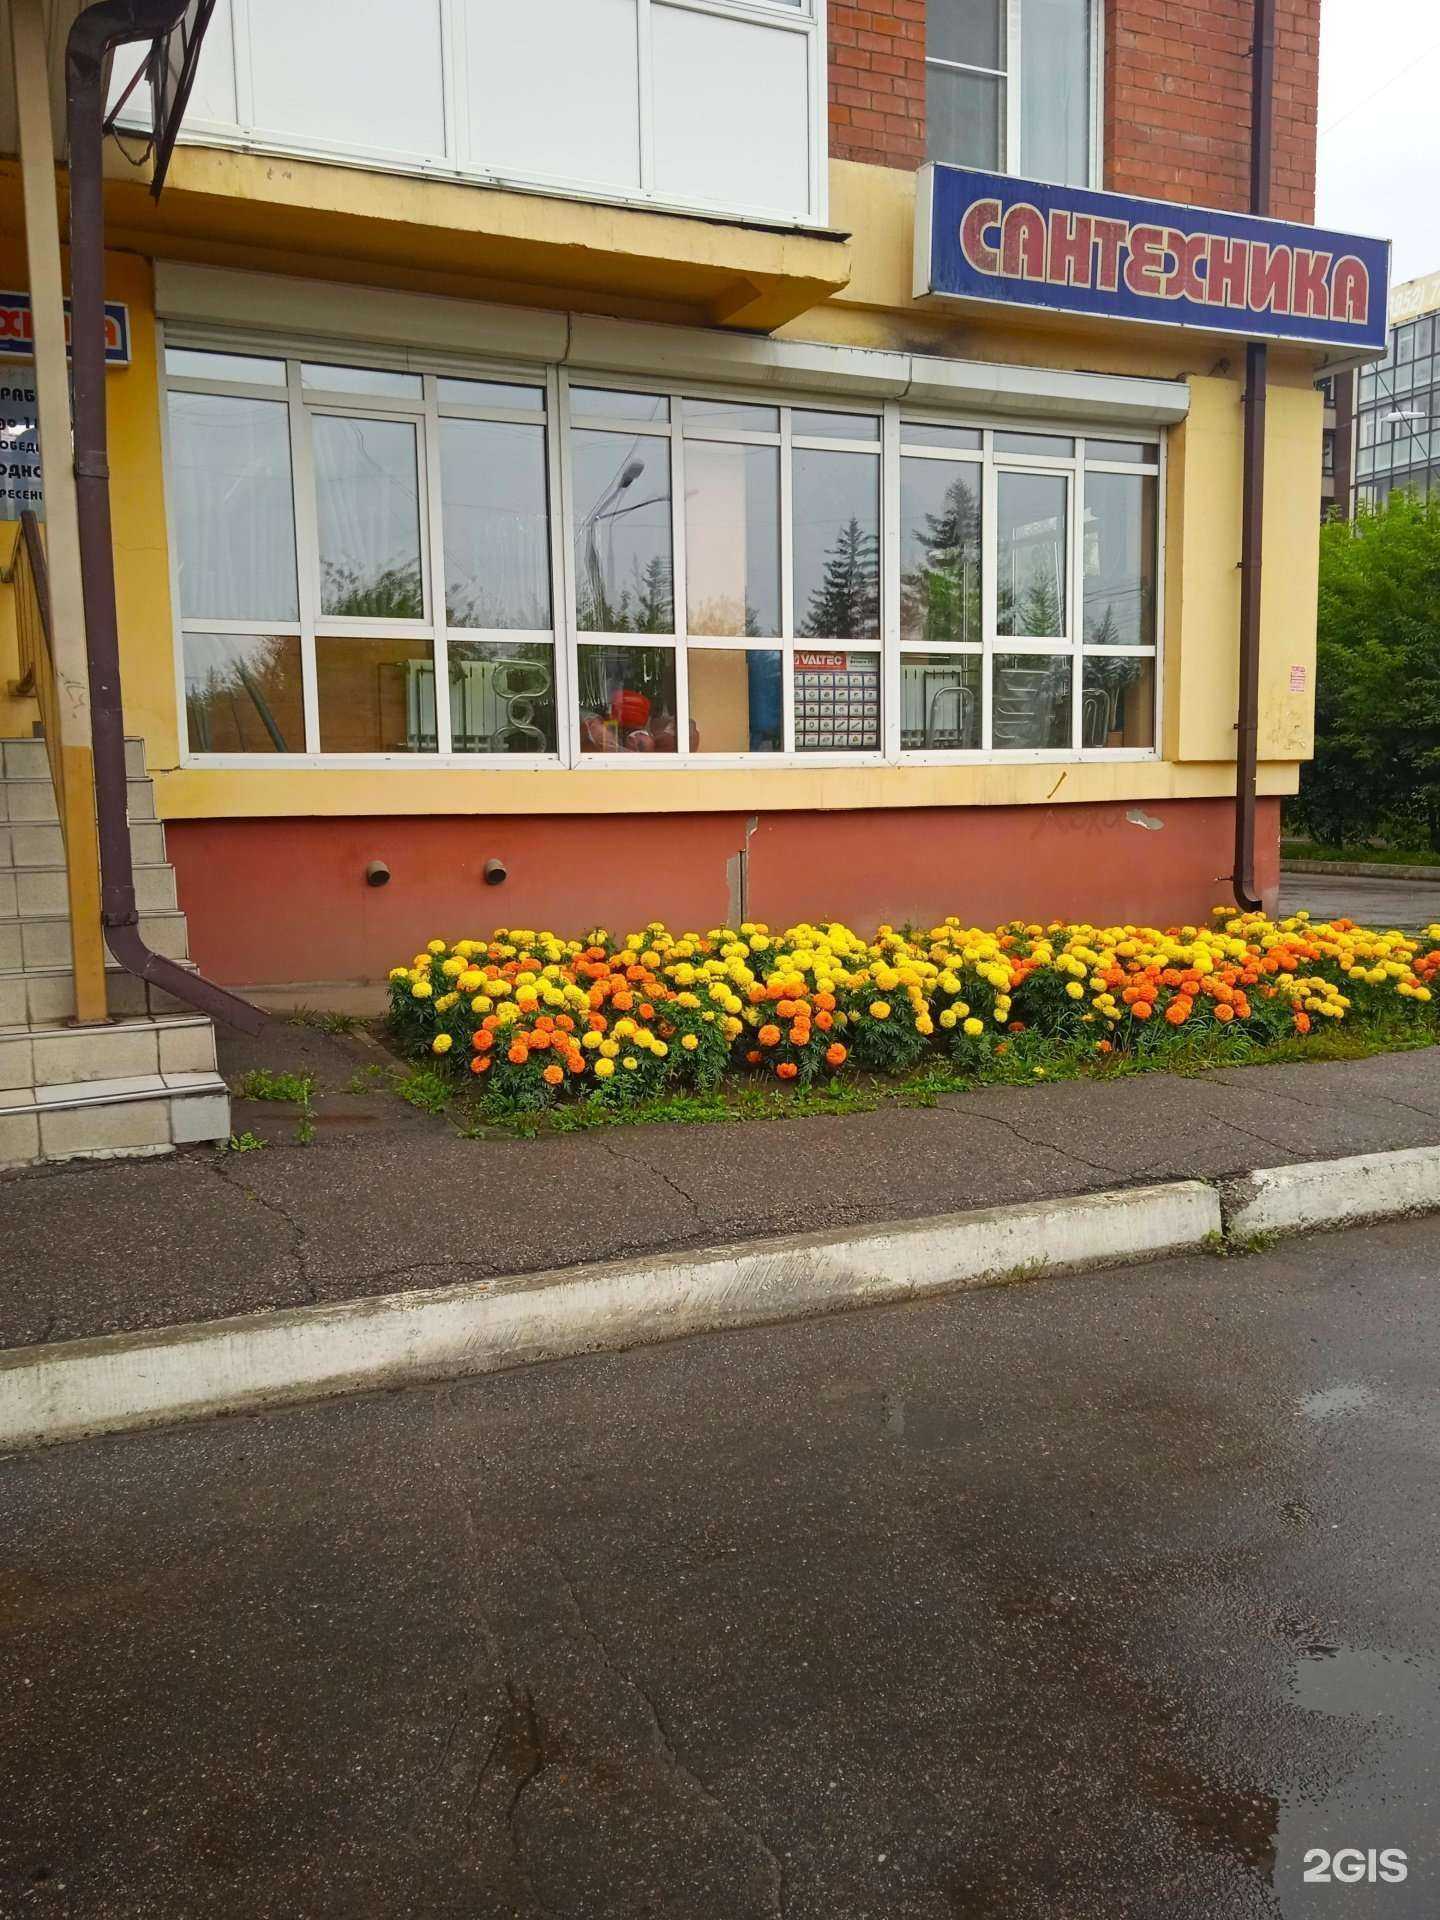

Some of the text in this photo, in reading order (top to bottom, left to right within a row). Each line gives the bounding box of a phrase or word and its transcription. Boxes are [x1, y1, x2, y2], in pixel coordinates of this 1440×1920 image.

[960, 198, 1370, 325] САНТЕХНИКА
[1, 387, 36, 402] РАБ
[800, 654, 842, 665] VALTEC
